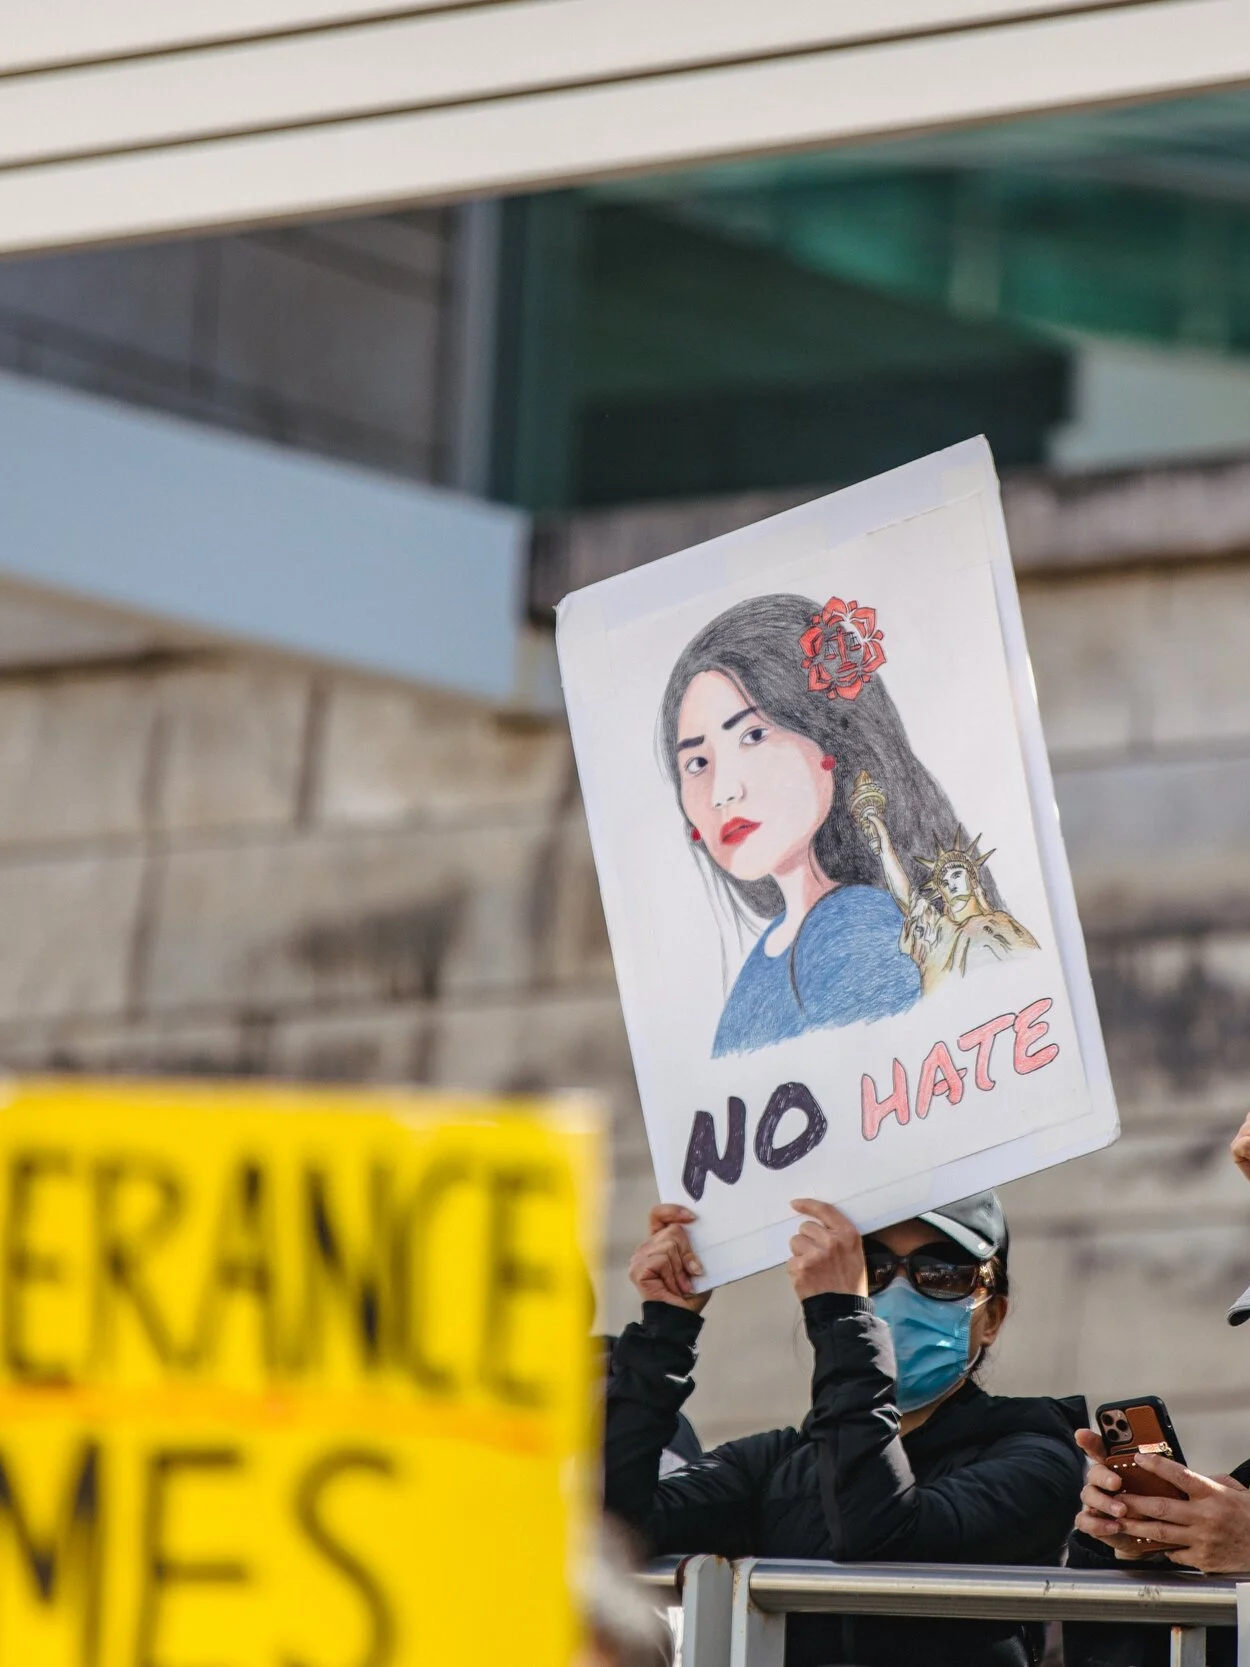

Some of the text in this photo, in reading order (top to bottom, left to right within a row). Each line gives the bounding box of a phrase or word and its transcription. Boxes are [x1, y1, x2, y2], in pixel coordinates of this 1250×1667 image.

[681, 997, 1060, 1202] NO HATE
[2, 1143, 566, 1408] ERANCE
